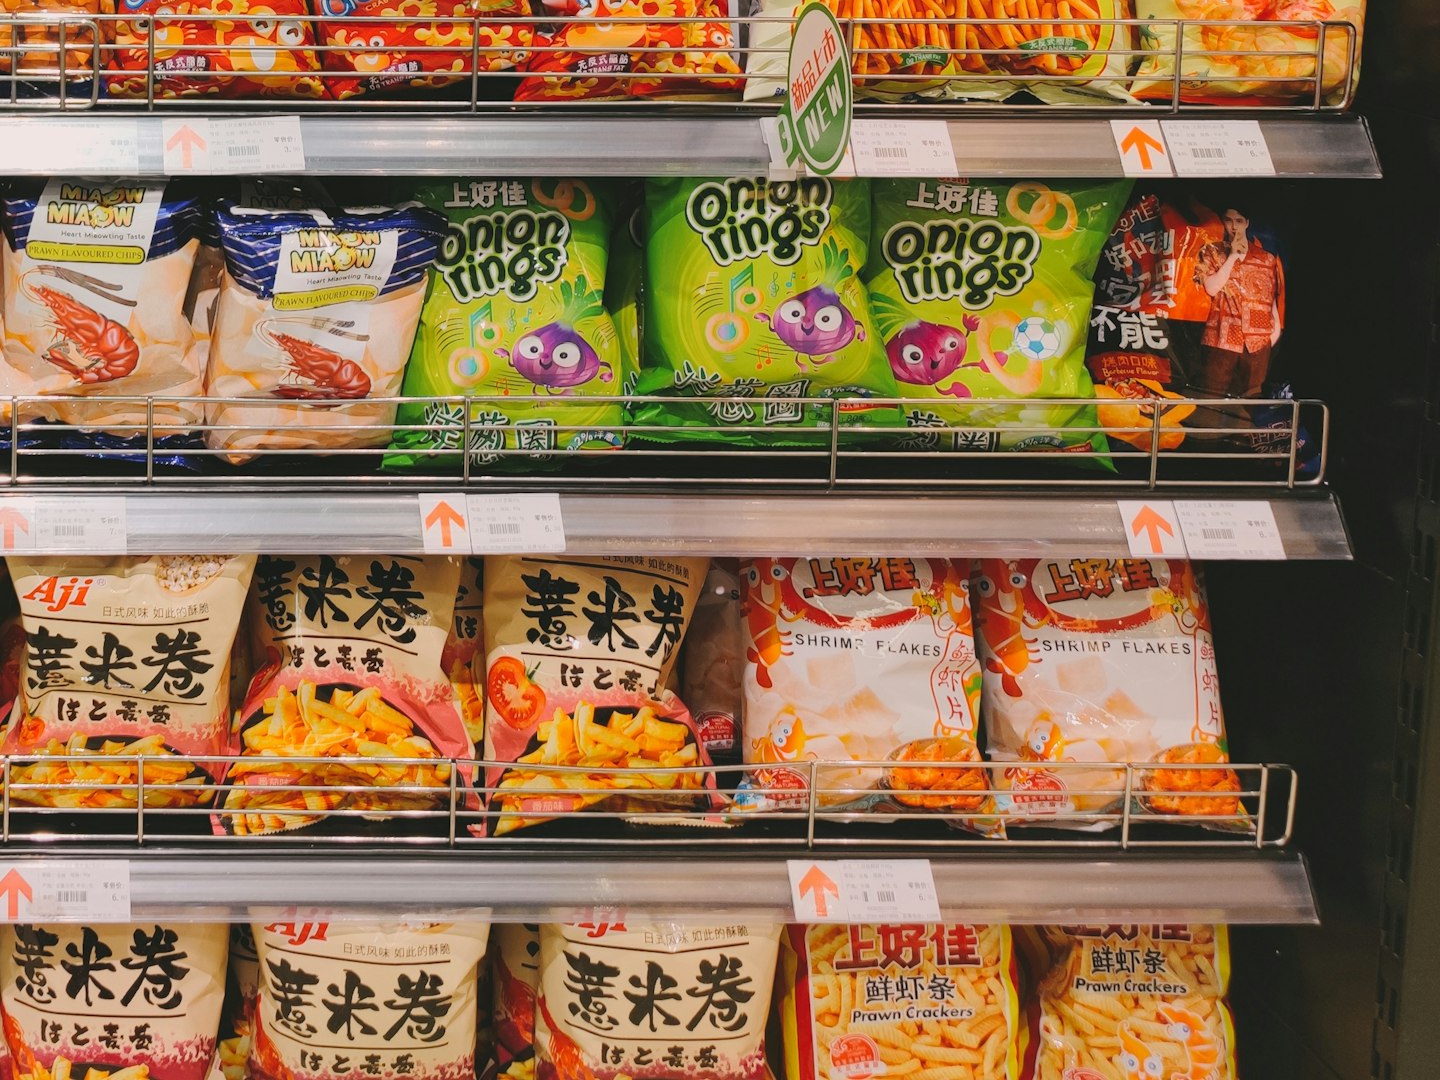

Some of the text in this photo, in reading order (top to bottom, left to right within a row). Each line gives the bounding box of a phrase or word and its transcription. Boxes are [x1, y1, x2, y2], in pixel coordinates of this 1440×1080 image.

[791, 27, 837, 114] 新品上市
[802, 79, 844, 149] NEW
[445, 182, 528, 207] 上好佳
[907, 182, 999, 217] 上好佳
[47, 203, 135, 227] MIAOW
[61, 230, 82, 238] Heart
[710, 210, 831, 265] rings
[29, 246, 142, 260] PRAWN FLAVOURED CHIPS
[291, 248, 376, 273] MIAOW
[446, 249, 563, 303] rings
[895, 257, 1037, 306] rings
[274, 288, 375, 307] PRAWN FLAVOURED CHIPS
[1090, 305, 1168, 350] 不能
[23, 575, 94, 612] Aji
[805, 559, 922, 598] 上好佳
[1045, 559, 1158, 602] 上好佳
[102, 602, 209, 619] 日式风味 如此的酥脆
[26, 626, 216, 699] 薏米卷
[876, 640, 941, 656] FLAKES
[1042, 637, 1191, 656] SHRIMP FLAKES
[264, 908, 330, 949] Aji
[13, 923, 191, 1009] 薏米卷
[343, 941, 452, 958] 日式风味 如此的酥脆
[1091, 947, 1167, 976] 鲜虾条
[268, 958, 452, 1043] 薏米卷
[564, 947, 755, 1033] 薏米卷
[865, 974, 955, 1003] 鲜虾条
[1075, 978, 1187, 996] Prawn Crackers
[852, 1003, 975, 1024] Prawn Crackers
